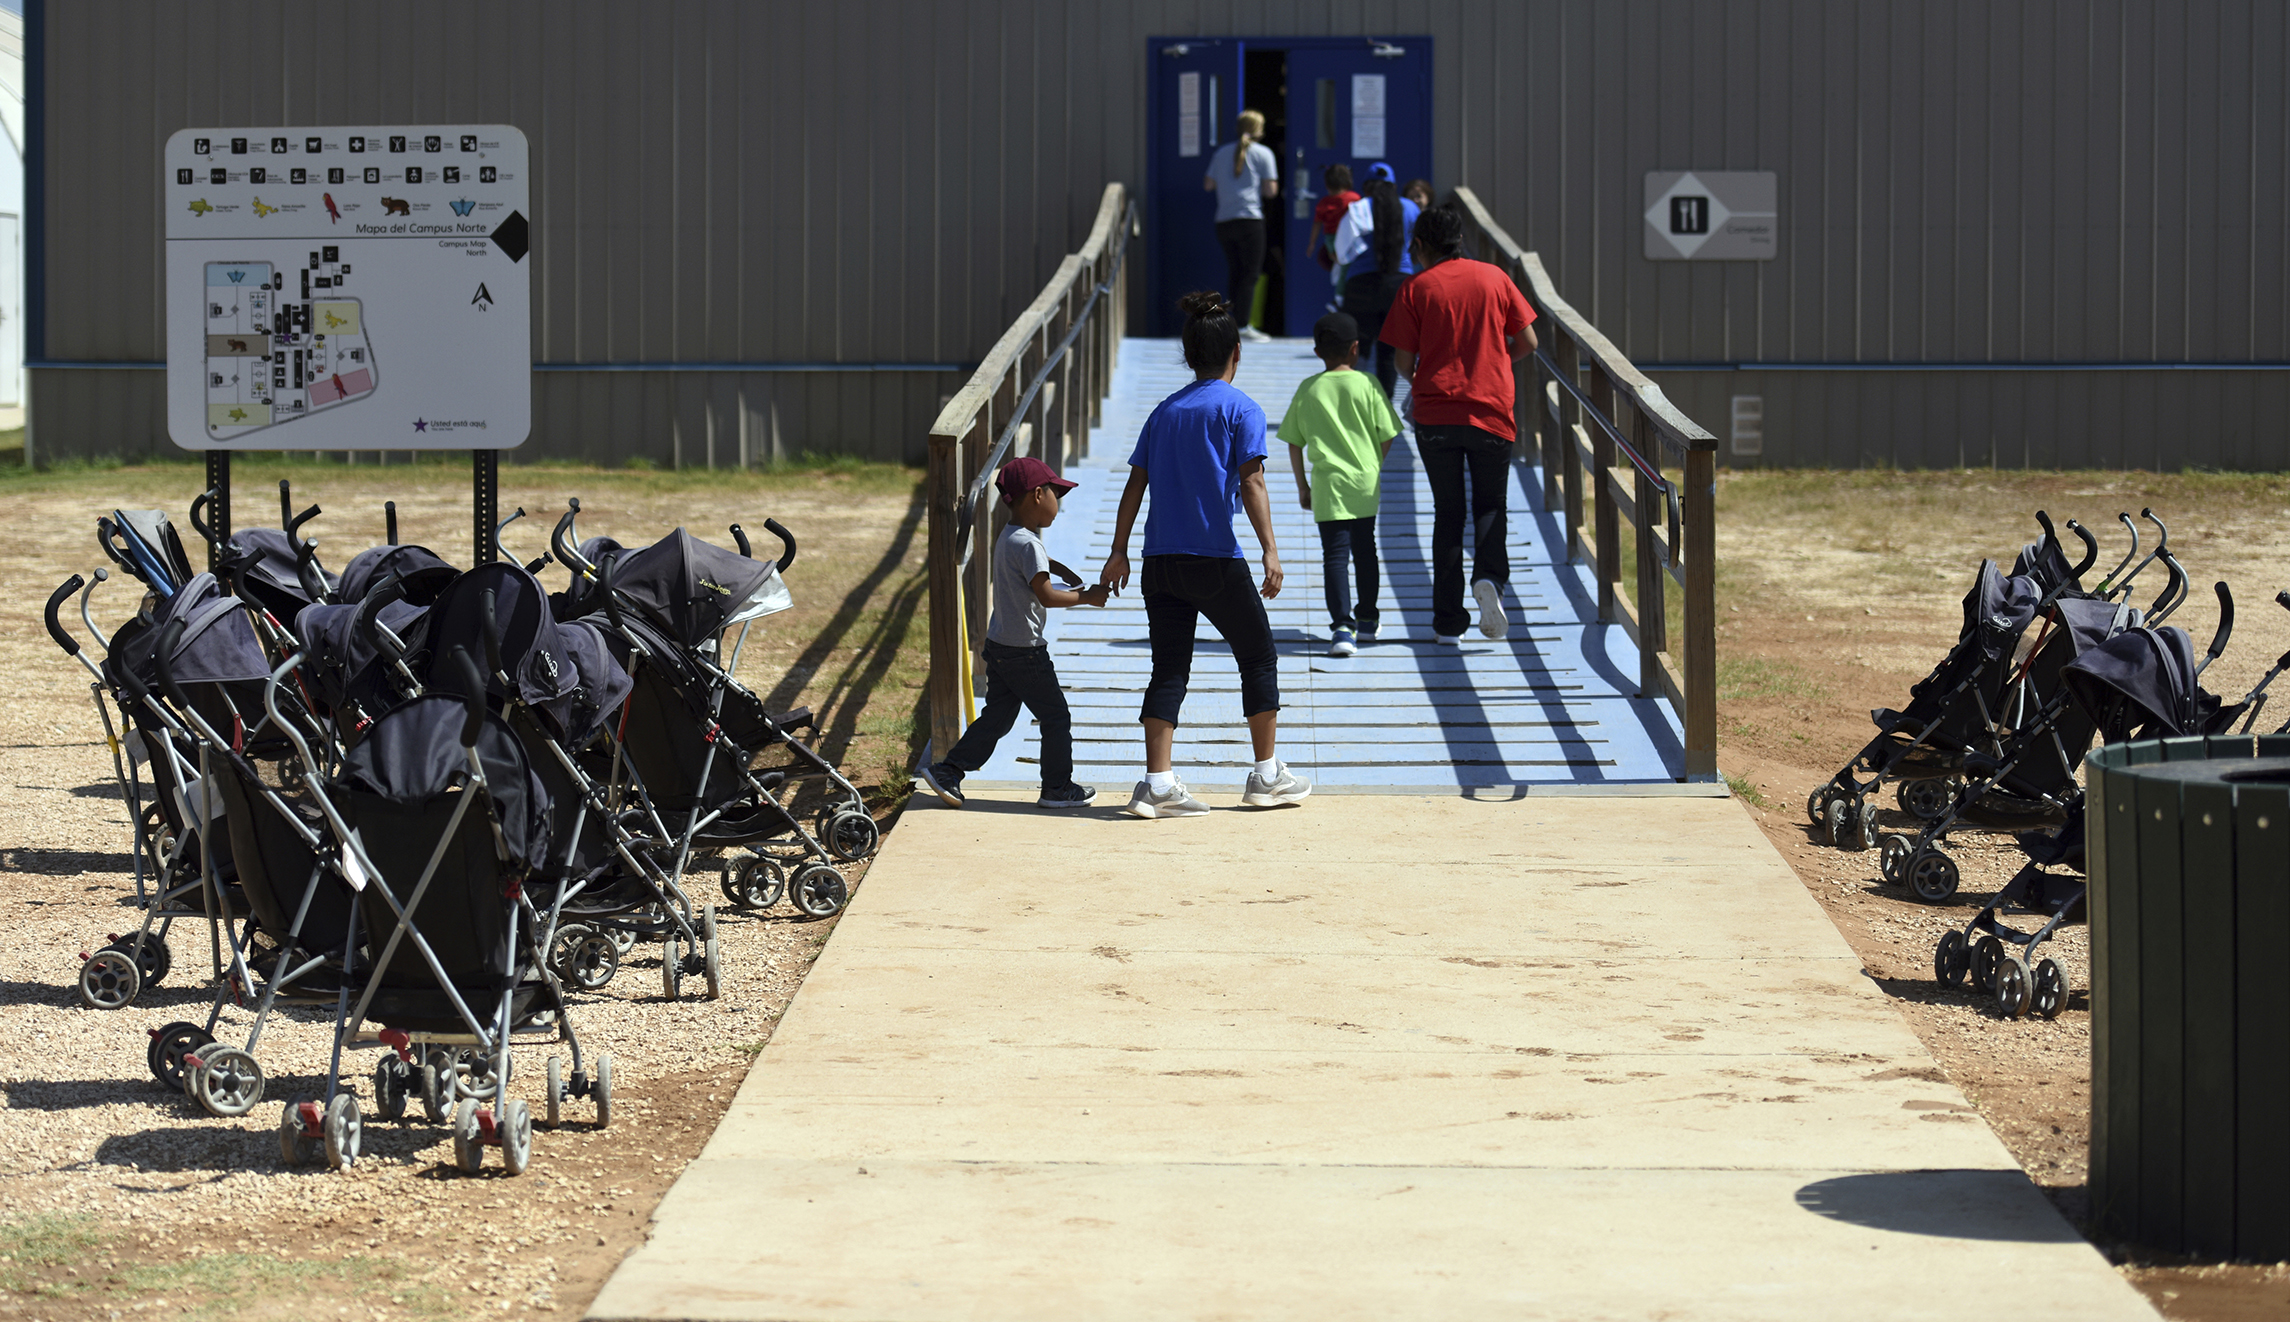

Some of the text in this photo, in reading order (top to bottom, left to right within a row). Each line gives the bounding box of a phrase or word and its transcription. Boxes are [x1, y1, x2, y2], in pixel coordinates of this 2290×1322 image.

[355, 222, 487, 236] Mapa del Campus Norte
[438, 240, 487, 249] Campus Map
[466, 249, 487, 257] North
[478, 303, 487, 312] N
[430, 419, 451, 428] Usted
[452, 419, 468, 428] está
